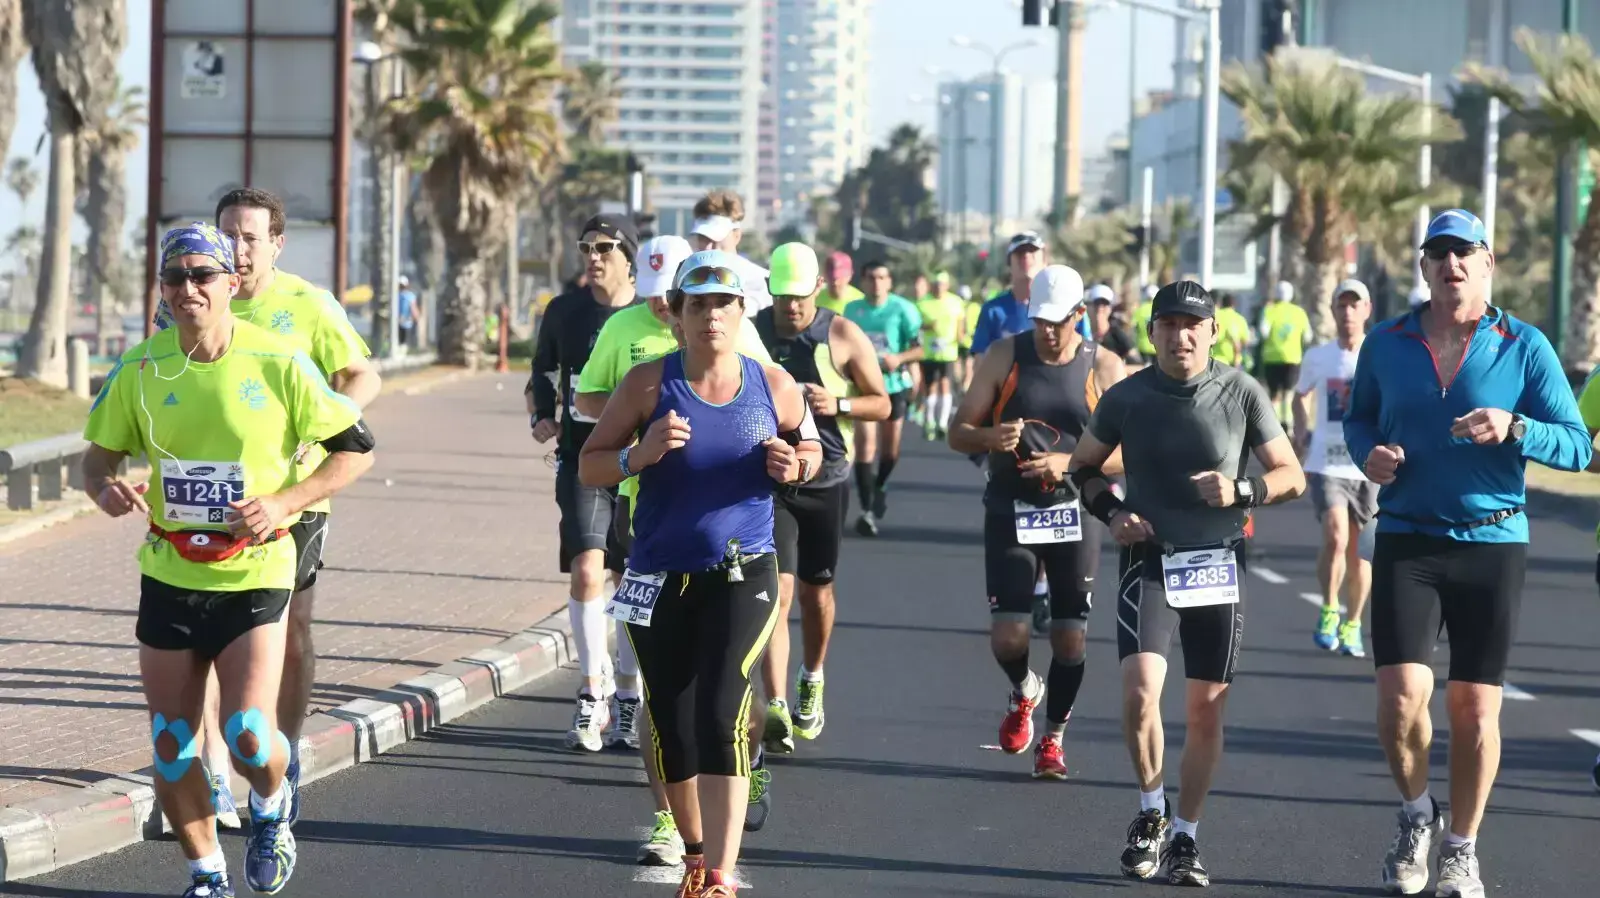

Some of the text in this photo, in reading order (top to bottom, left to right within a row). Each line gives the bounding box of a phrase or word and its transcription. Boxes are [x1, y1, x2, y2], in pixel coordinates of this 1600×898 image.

[168, 482, 233, 502] B 1241
[1019, 509, 1072, 527] B 2346
[1169, 566, 1230, 587] B 2835
